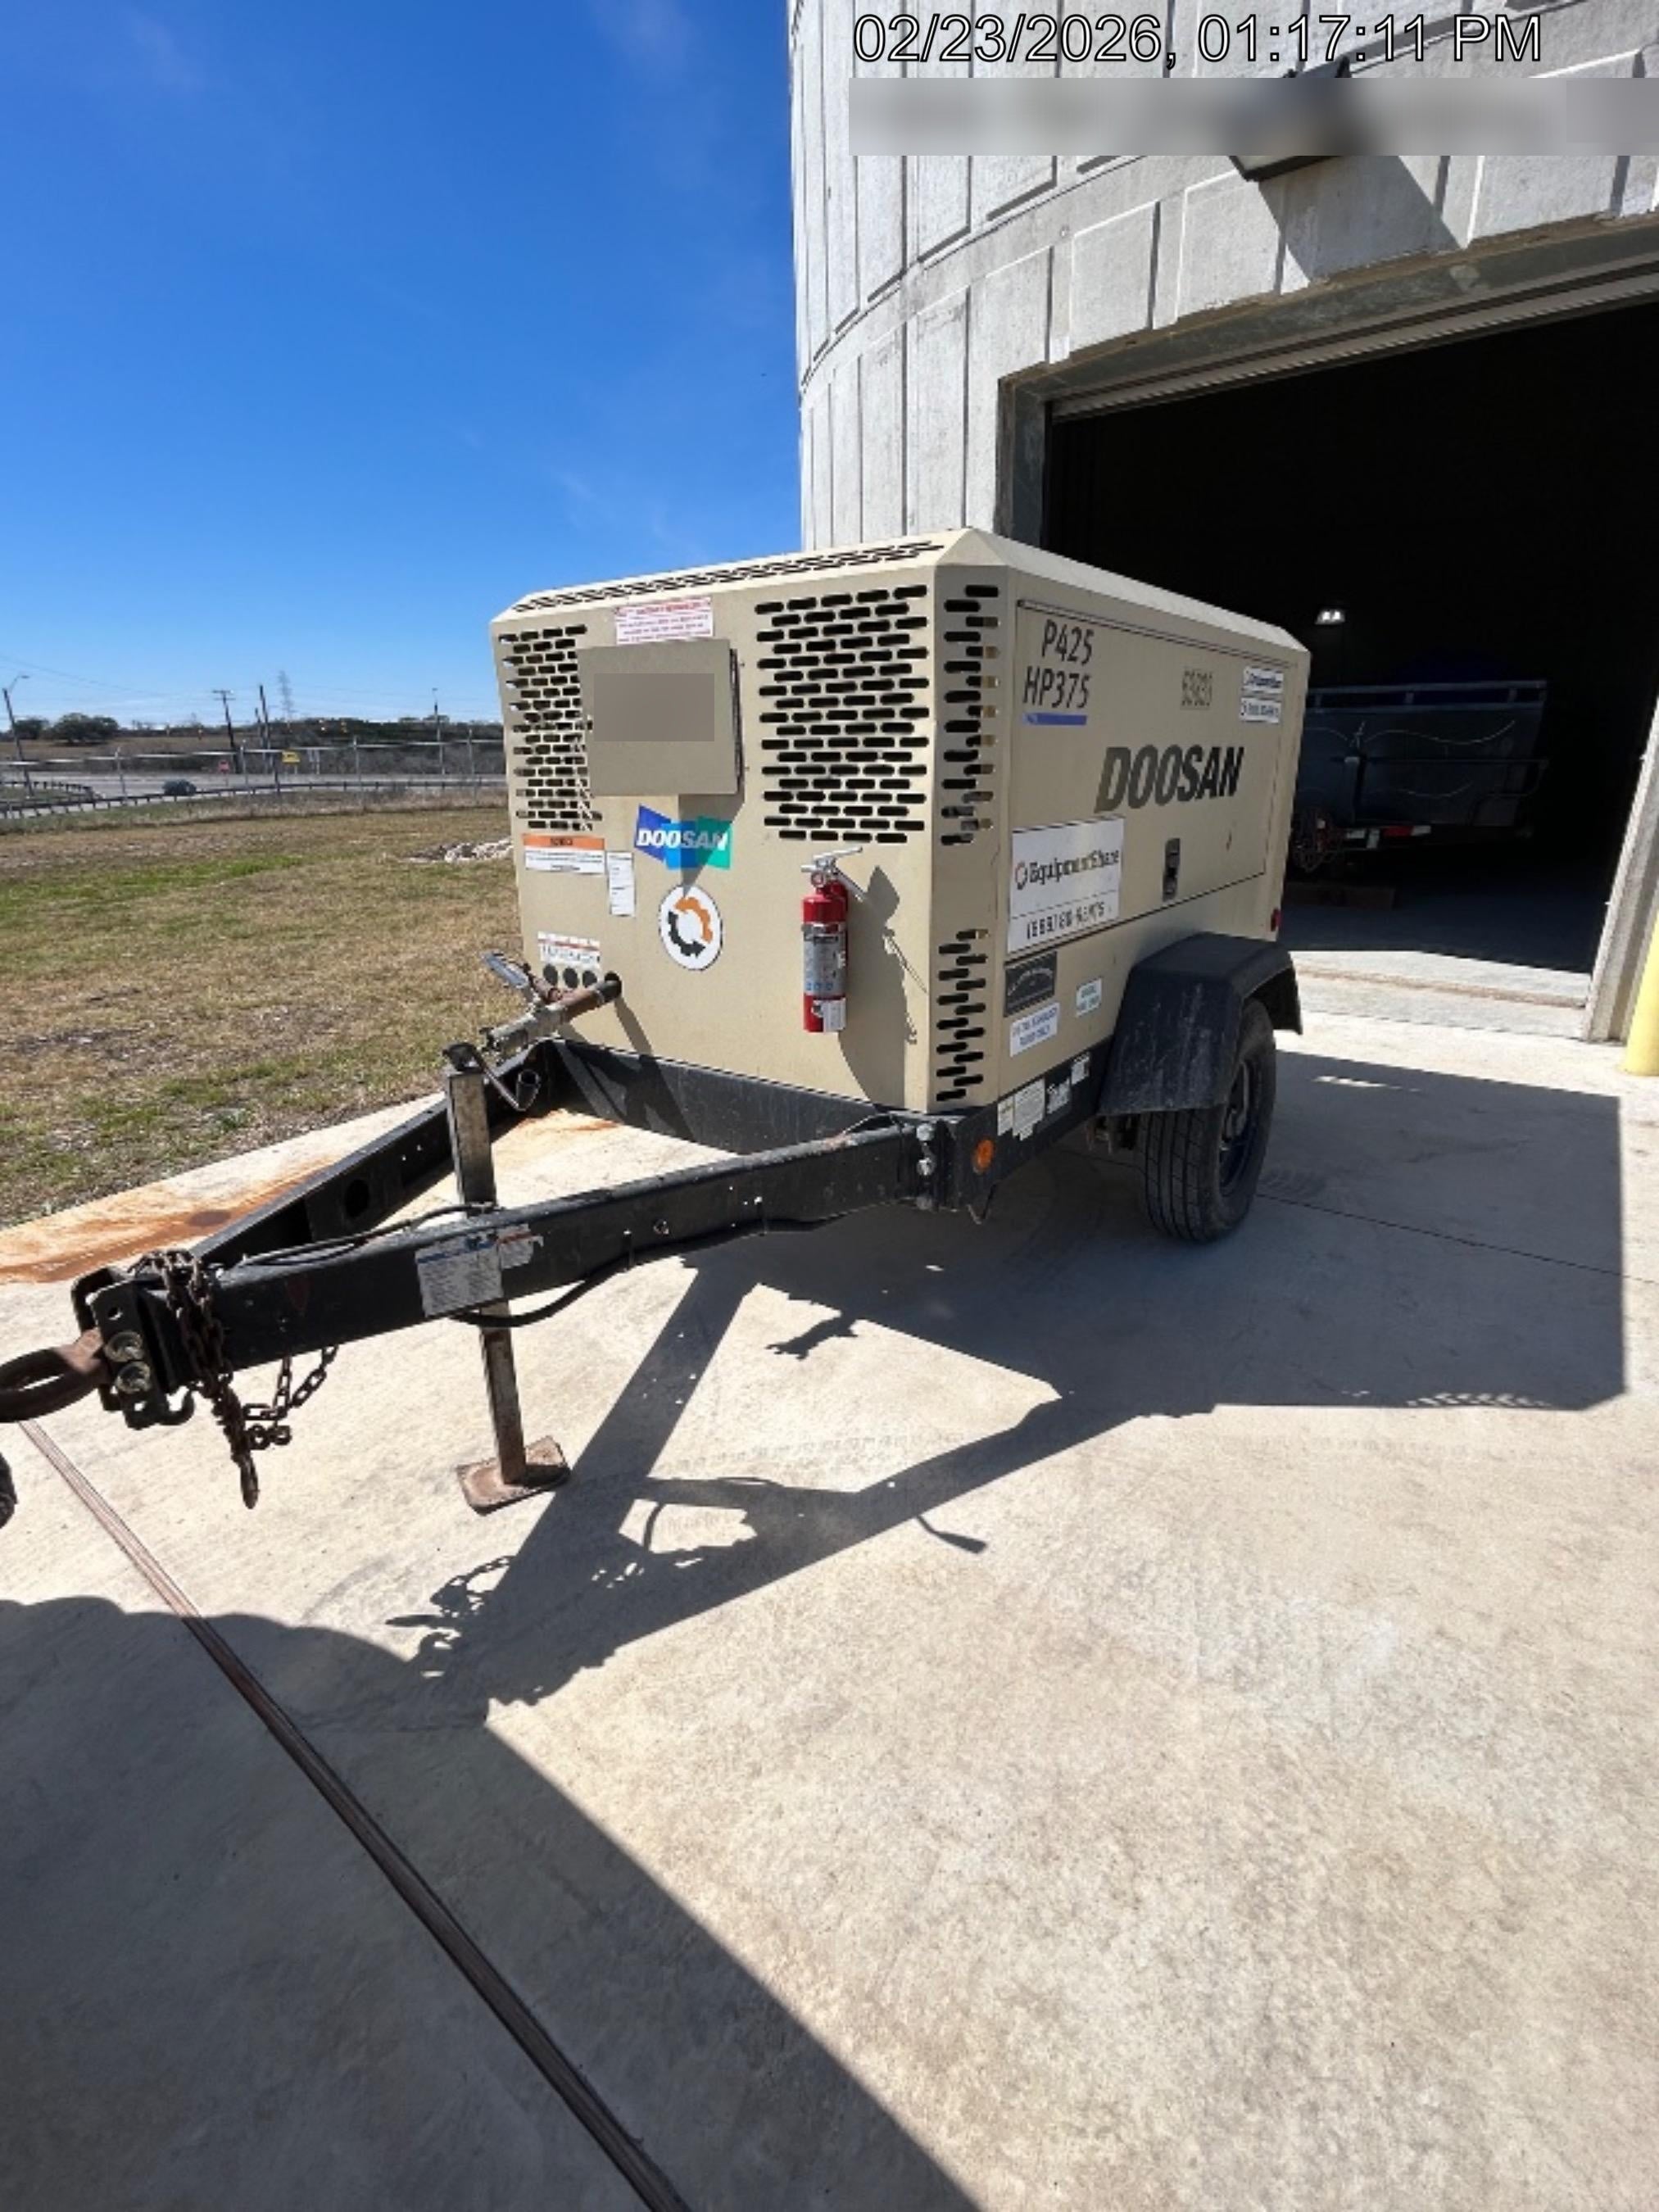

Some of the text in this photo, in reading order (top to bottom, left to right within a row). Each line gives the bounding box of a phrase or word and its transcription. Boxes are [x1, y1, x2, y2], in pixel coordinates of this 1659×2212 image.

[1041, 619, 1095, 665] P425
[1023, 665, 1092, 709] HP375
[1094, 744, 1244, 814] DOOSAN
[636, 827, 728, 851] DOOSAN
